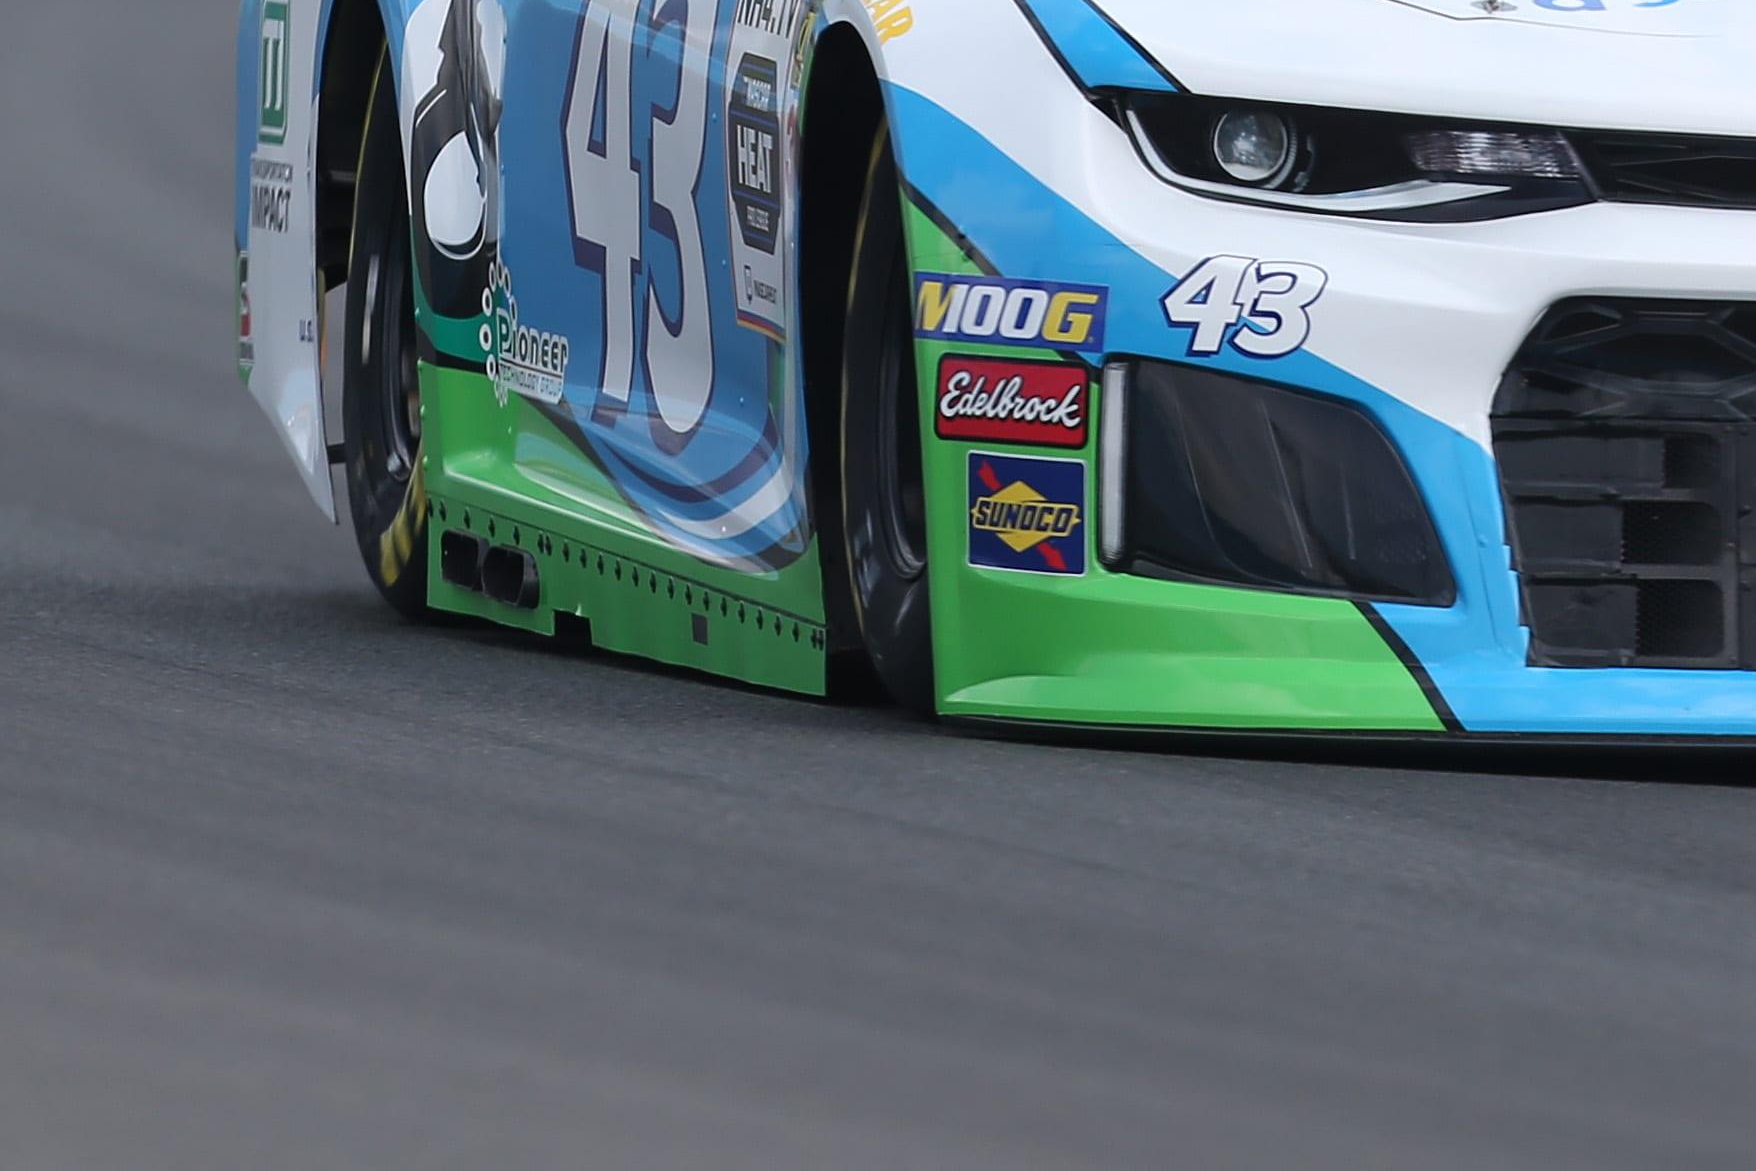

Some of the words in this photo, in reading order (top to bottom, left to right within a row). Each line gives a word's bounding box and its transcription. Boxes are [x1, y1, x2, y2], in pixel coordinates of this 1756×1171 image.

[737, 124, 773, 193] HEAT
[916, 280, 1099, 344] MOOG
[1159, 254, 1328, 358] 43
[938, 369, 1083, 429] Edelbrock
[975, 499, 1077, 534] SUNOCO
